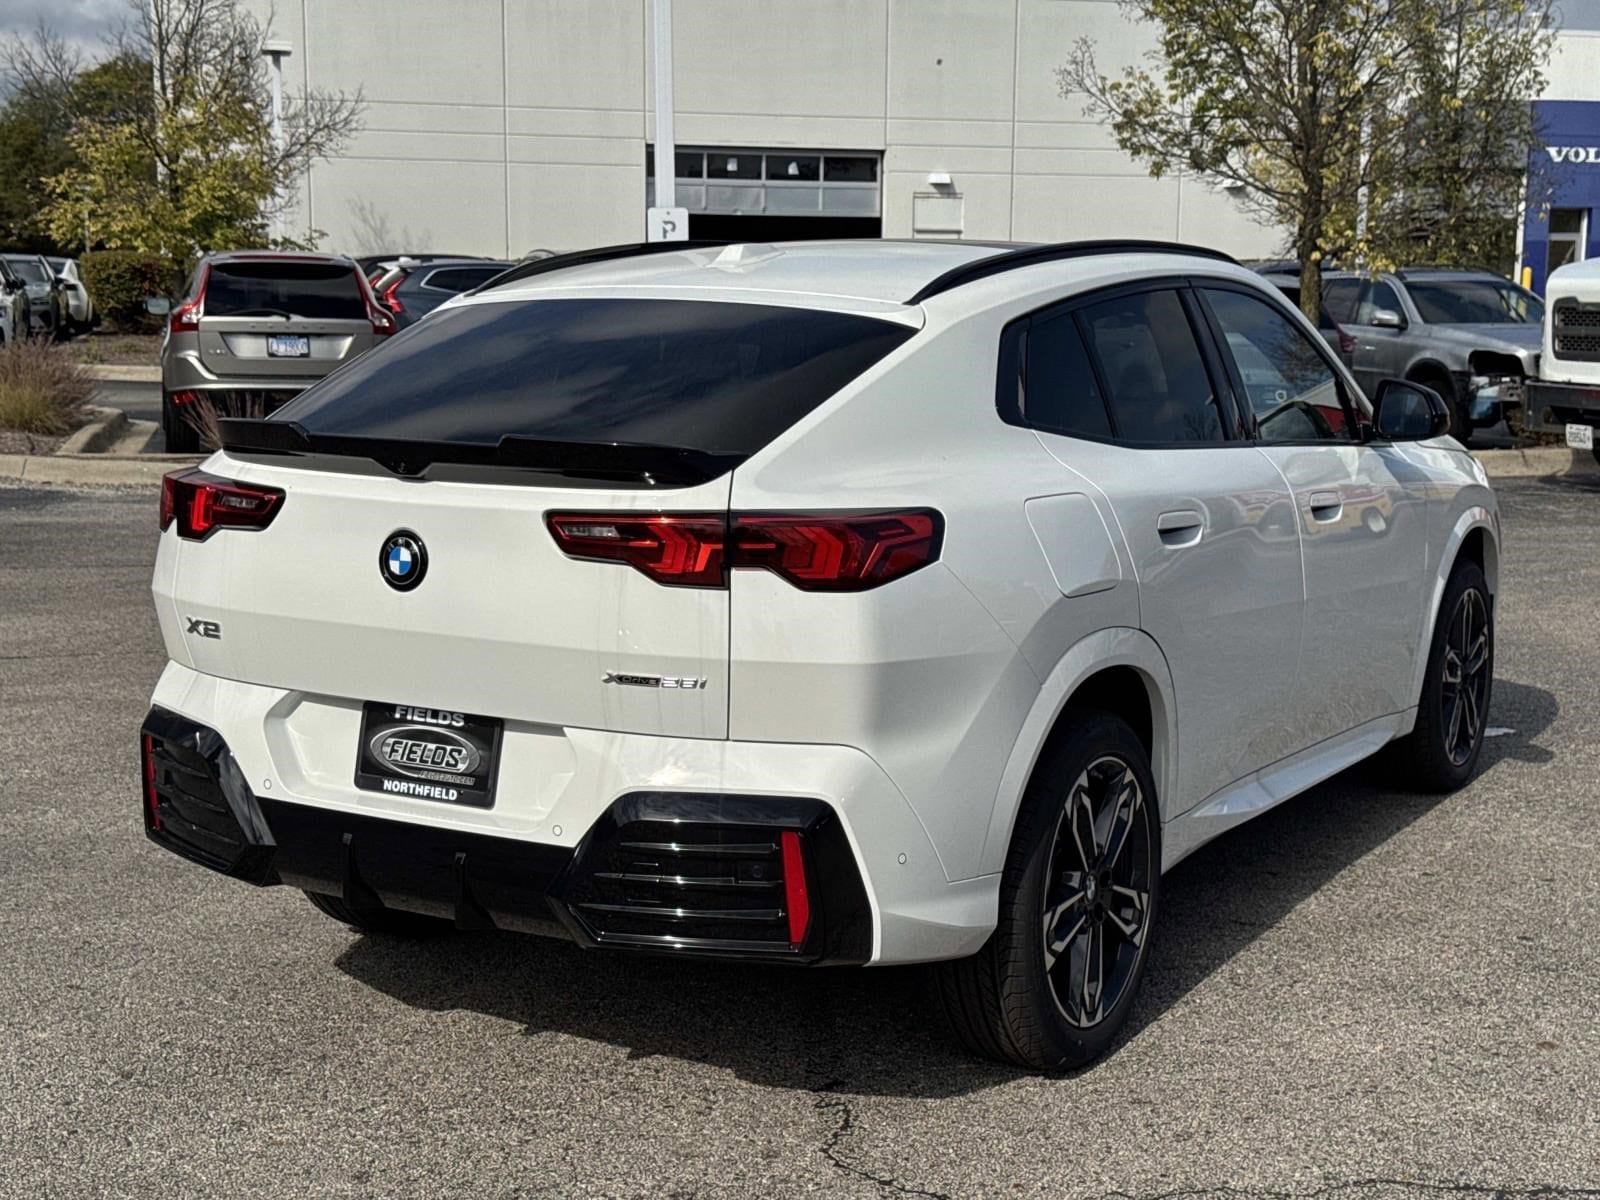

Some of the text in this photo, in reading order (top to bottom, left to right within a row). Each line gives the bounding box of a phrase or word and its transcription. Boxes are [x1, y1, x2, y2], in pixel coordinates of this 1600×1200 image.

[186, 616, 221, 640] X2
[394, 705, 465, 727] FIELDS
[388, 740, 463, 769] FIELDS
[383, 779, 458, 801] NORTHFIELD
